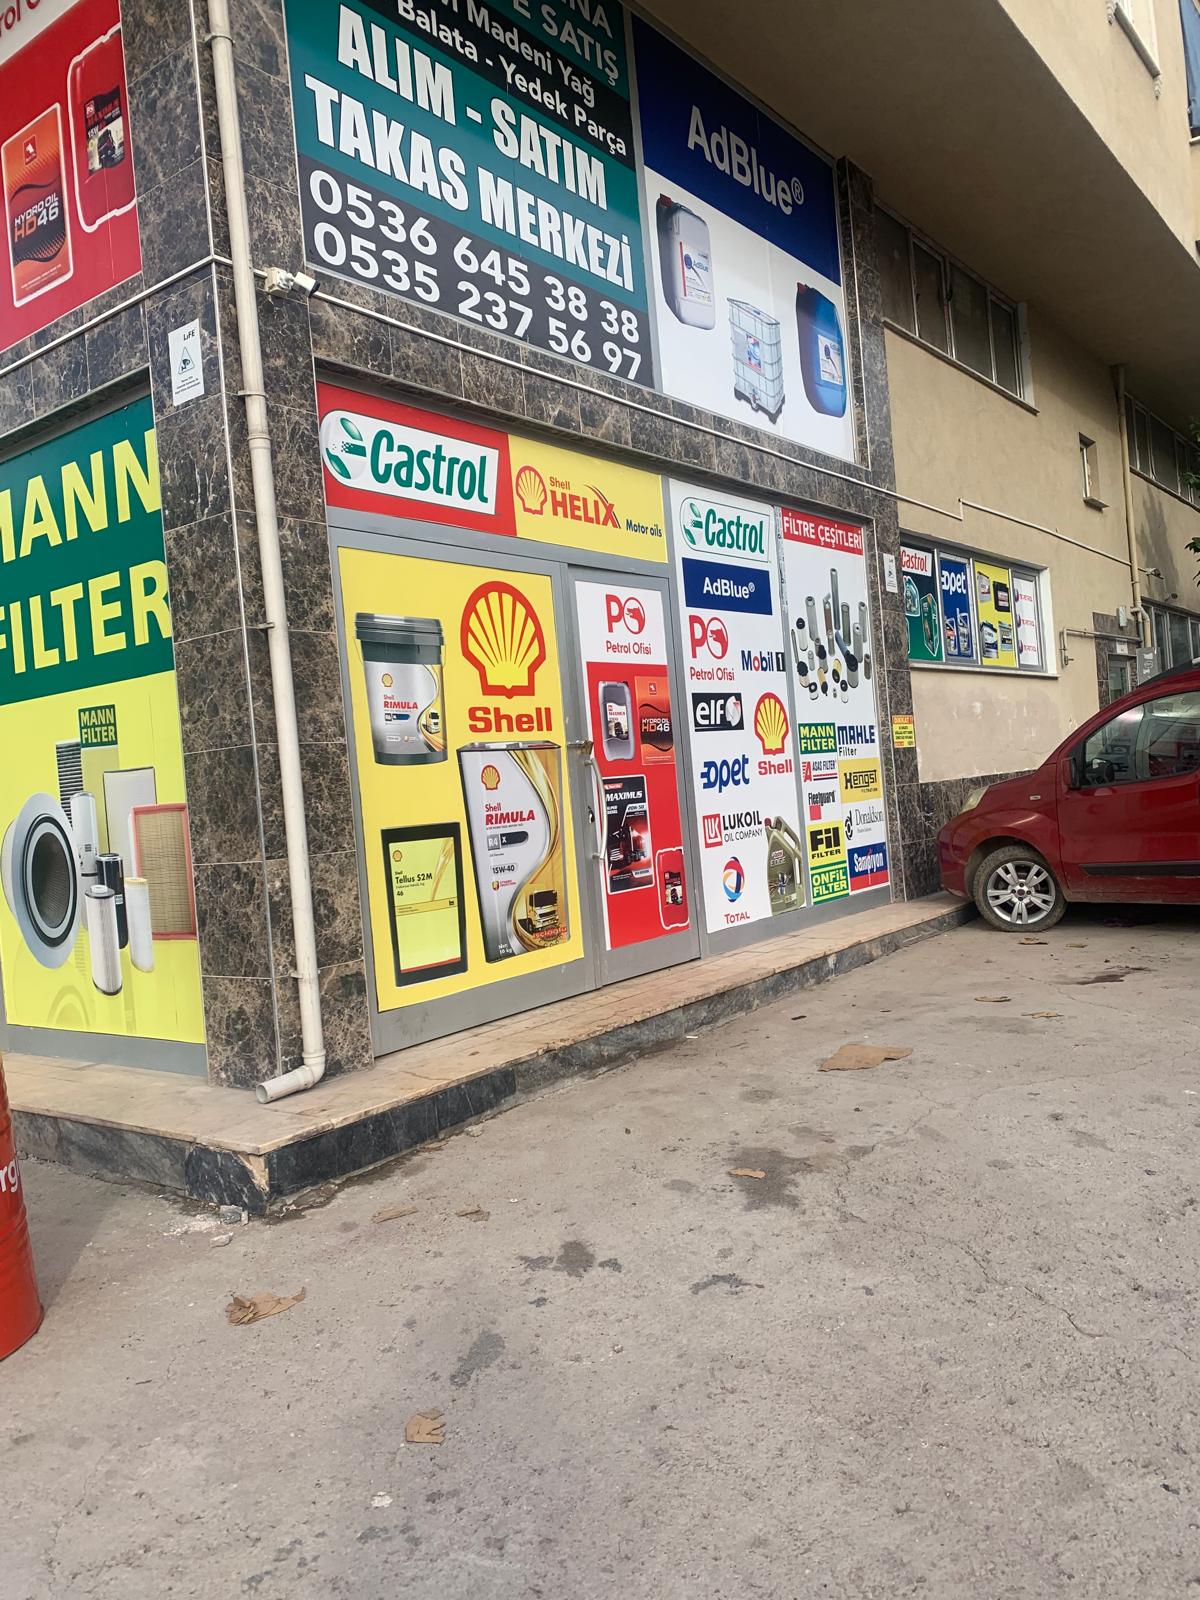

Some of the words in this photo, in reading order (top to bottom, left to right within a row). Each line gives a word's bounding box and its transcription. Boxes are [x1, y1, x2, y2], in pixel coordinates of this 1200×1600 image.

[467, 0, 552, 75] Madeni
[557, 58, 595, 108] Yağ
[541, 4, 619, 86] SATIŞ
[398, 0, 478, 63] Balata
[499, 54, 567, 116] Yedek
[574, 111, 627, 156] Parça
[337, 3, 456, 127] ALIM
[490, 96, 608, 211] SATIM
[304, 72, 470, 212] TAKAS
[477, 165, 635, 293] MERKEZİ
[15, 200, 44, 227] HYDRO
[45, 192, 59, 207] OIL
[309, 169, 437, 256] 0536
[453, 236, 531, 296] 645
[544, 275, 589, 321] 38
[600, 300, 640, 344] 38
[313, 221, 440, 303] 0535
[456, 280, 533, 338] 237
[549, 316, 592, 363] 56
[602, 341, 642, 381] 97
[370, 429, 488, 504] Castrol
[549, 476, 571, 491] Shell
[550, 489, 620, 529] HELIX
[626, 519, 648, 533] Motor
[650, 525, 662, 538] oils
[704, 508, 765, 555] Castrol
[783, 513, 816, 538] FİLTRE
[818, 524, 863, 549] ÇEŞİTLERİ
[902, 550, 928, 573] Castrol
[606, 641, 631, 655] Petrol
[632, 642, 652, 656] Ofisi
[741, 650, 774, 672] Mobil
[690, 666, 714, 681] Petrol
[716, 667, 735, 681] Ofisi
[383, 701, 418, 709] RIMULA
[695, 697, 724, 725] elf
[80, 708, 115, 727] MANN
[468, 706, 553, 733] Shell
[81, 725, 117, 744] FILTER
[800, 725, 834, 738] MANN
[837, 725, 876, 745] MAHLE
[801, 738, 835, 752] FILTER
[839, 747, 857, 756] Filter
[758, 759, 793, 776] Shell
[844, 769, 877, 790] Hengst
[606, 790, 642, 802] MAXIMUS
[808, 790, 836, 806] Fleetguard
[485, 803, 501, 812] Shell
[855, 806, 884, 826] Donaldson
[485, 809, 535, 826] RIMULA
[722, 810, 762, 831] LUKOIL
[724, 833, 734, 842] OIL
[735, 828, 763, 841] COMPANY
[811, 849, 841, 860] FILTER
[395, 875, 416, 884] Tellus
[814, 880, 848, 897] FILTER
[724, 911, 751, 924] TOTAL
